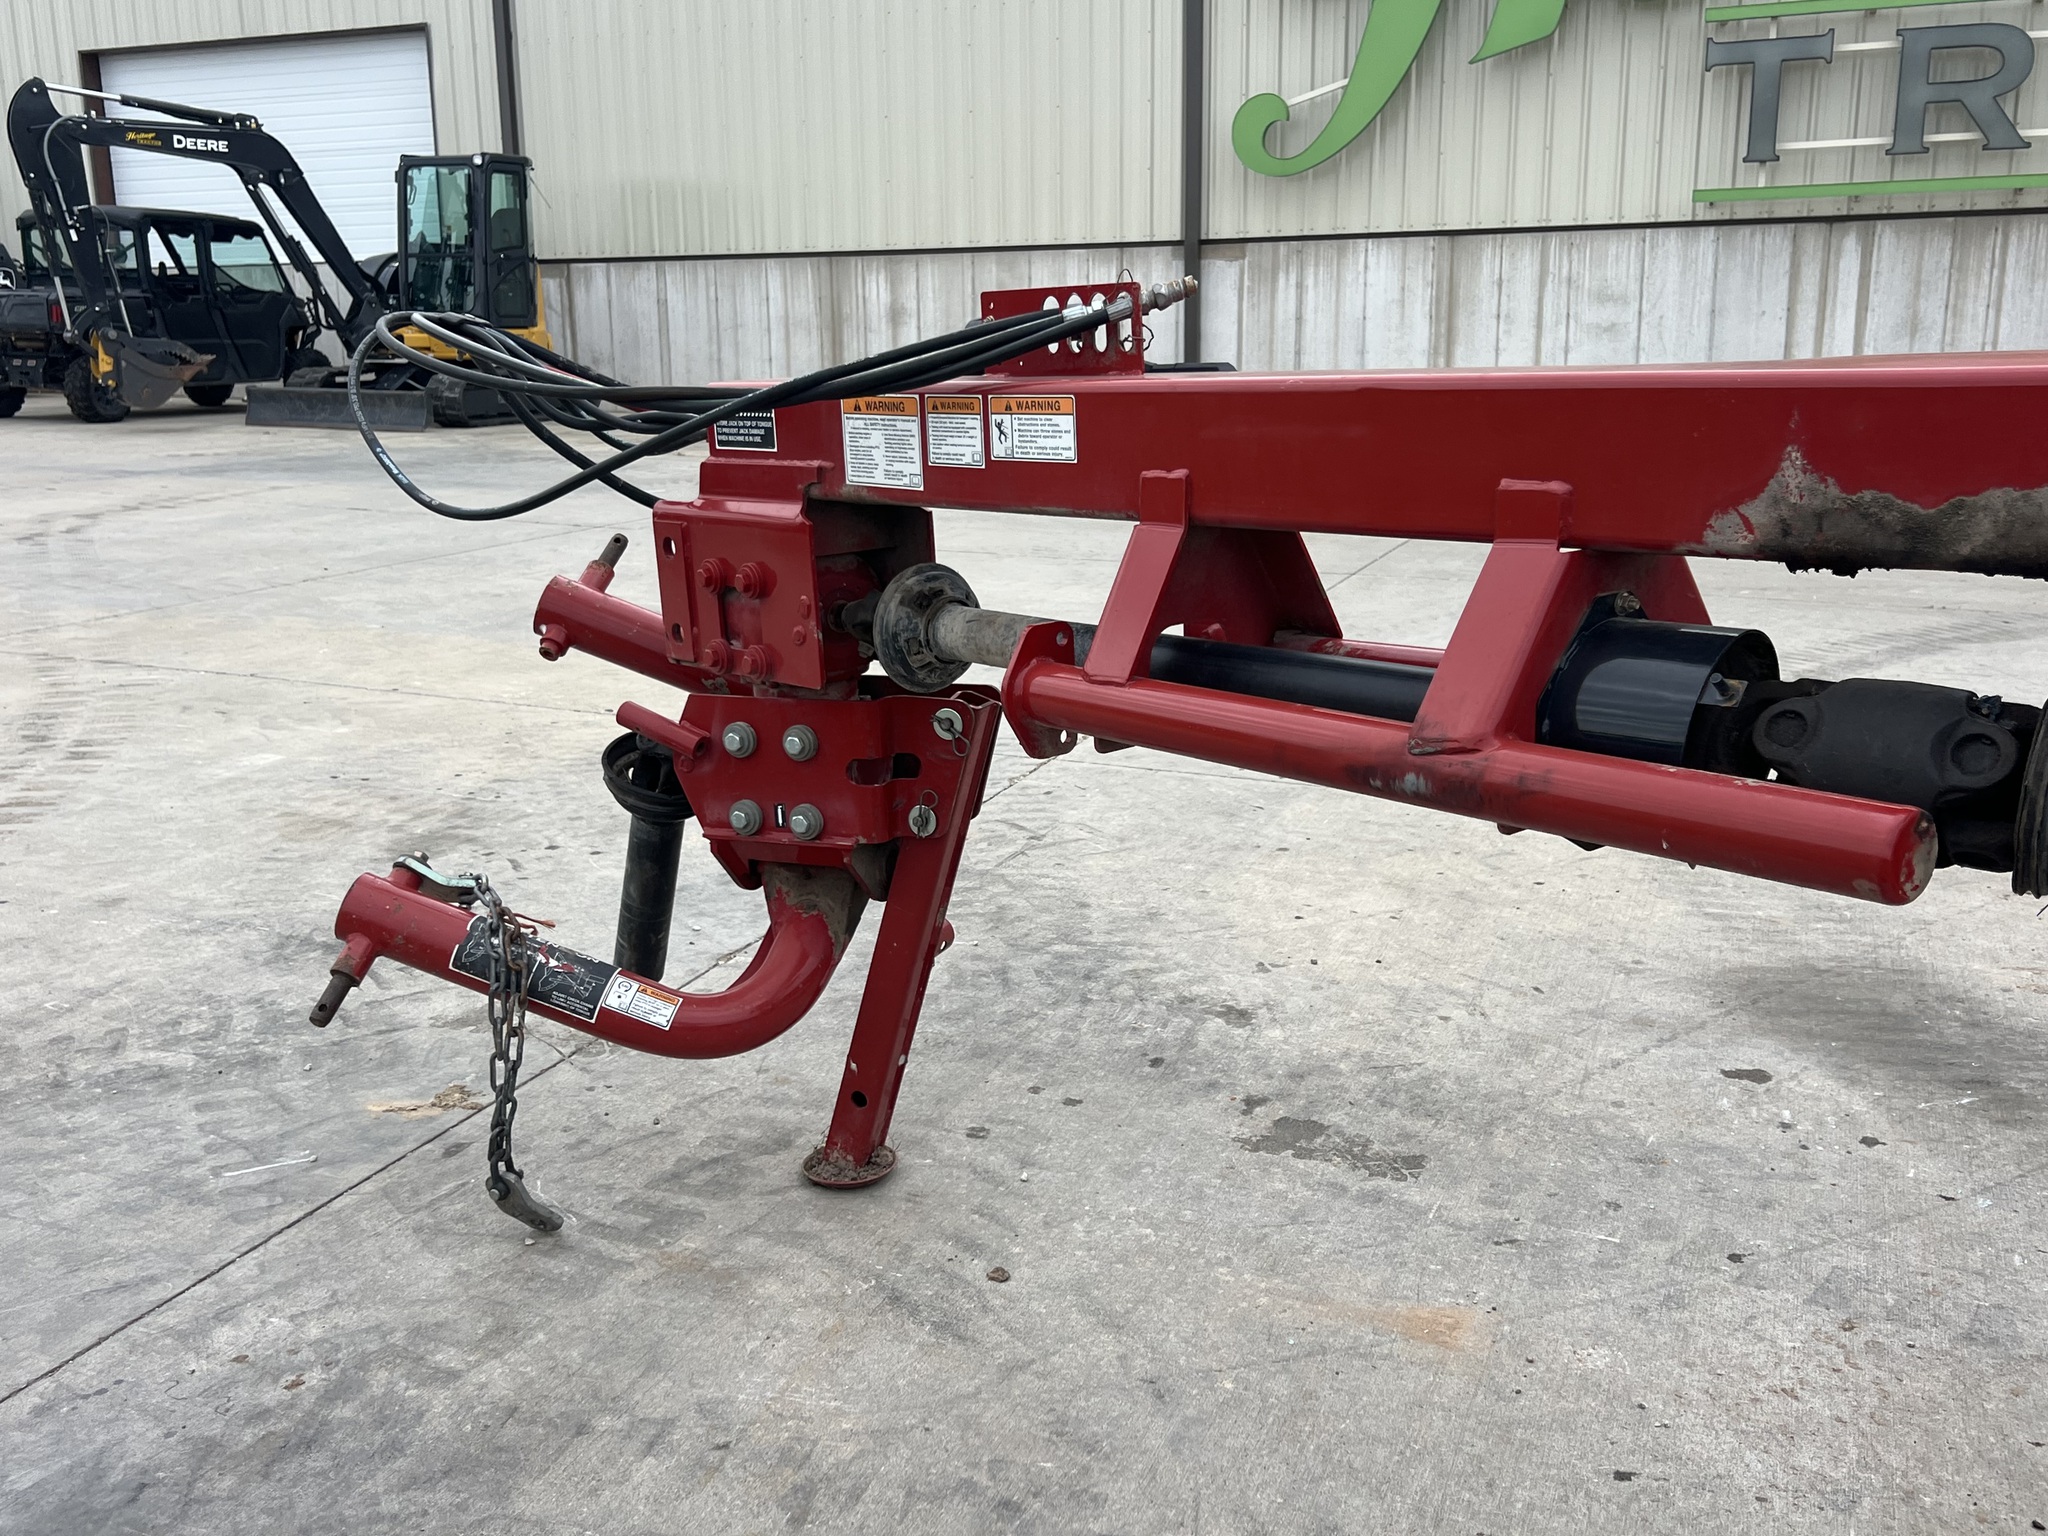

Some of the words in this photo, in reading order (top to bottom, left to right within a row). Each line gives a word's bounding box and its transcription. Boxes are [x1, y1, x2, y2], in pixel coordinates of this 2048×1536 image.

[172, 134, 229, 153] DEERE
[865, 401, 904, 412] WARNING
[940, 402, 974, 411] WARNING
[1016, 400, 1060, 411] WARNING
[650, 990, 676, 1003] WARNING
